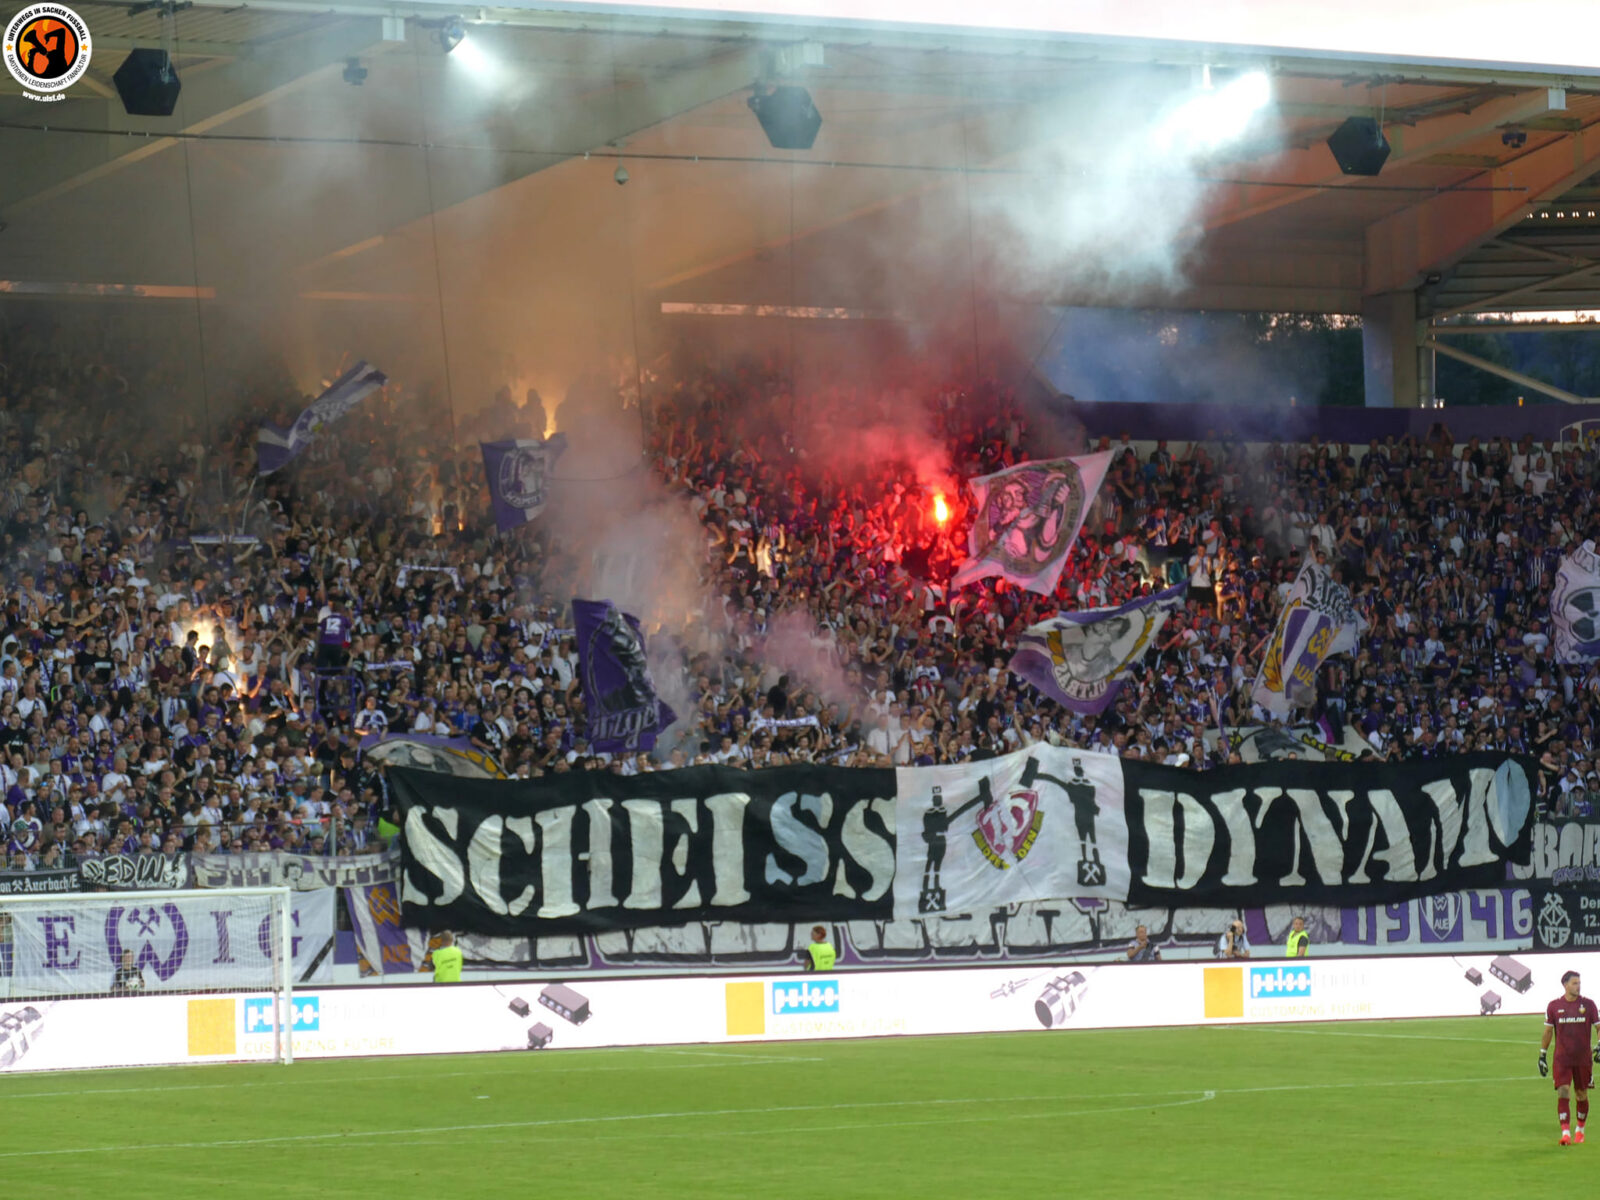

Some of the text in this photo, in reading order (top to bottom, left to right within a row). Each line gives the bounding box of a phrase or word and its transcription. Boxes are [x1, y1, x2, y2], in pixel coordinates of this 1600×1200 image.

[401, 791, 897, 918] SCHEISS
[1138, 758, 1531, 891] DYNAMO
[37, 902, 303, 982] EWIG
[1433, 918, 1450, 930] AUE
[244, 1038, 337, 1055] CUSOMIZING
